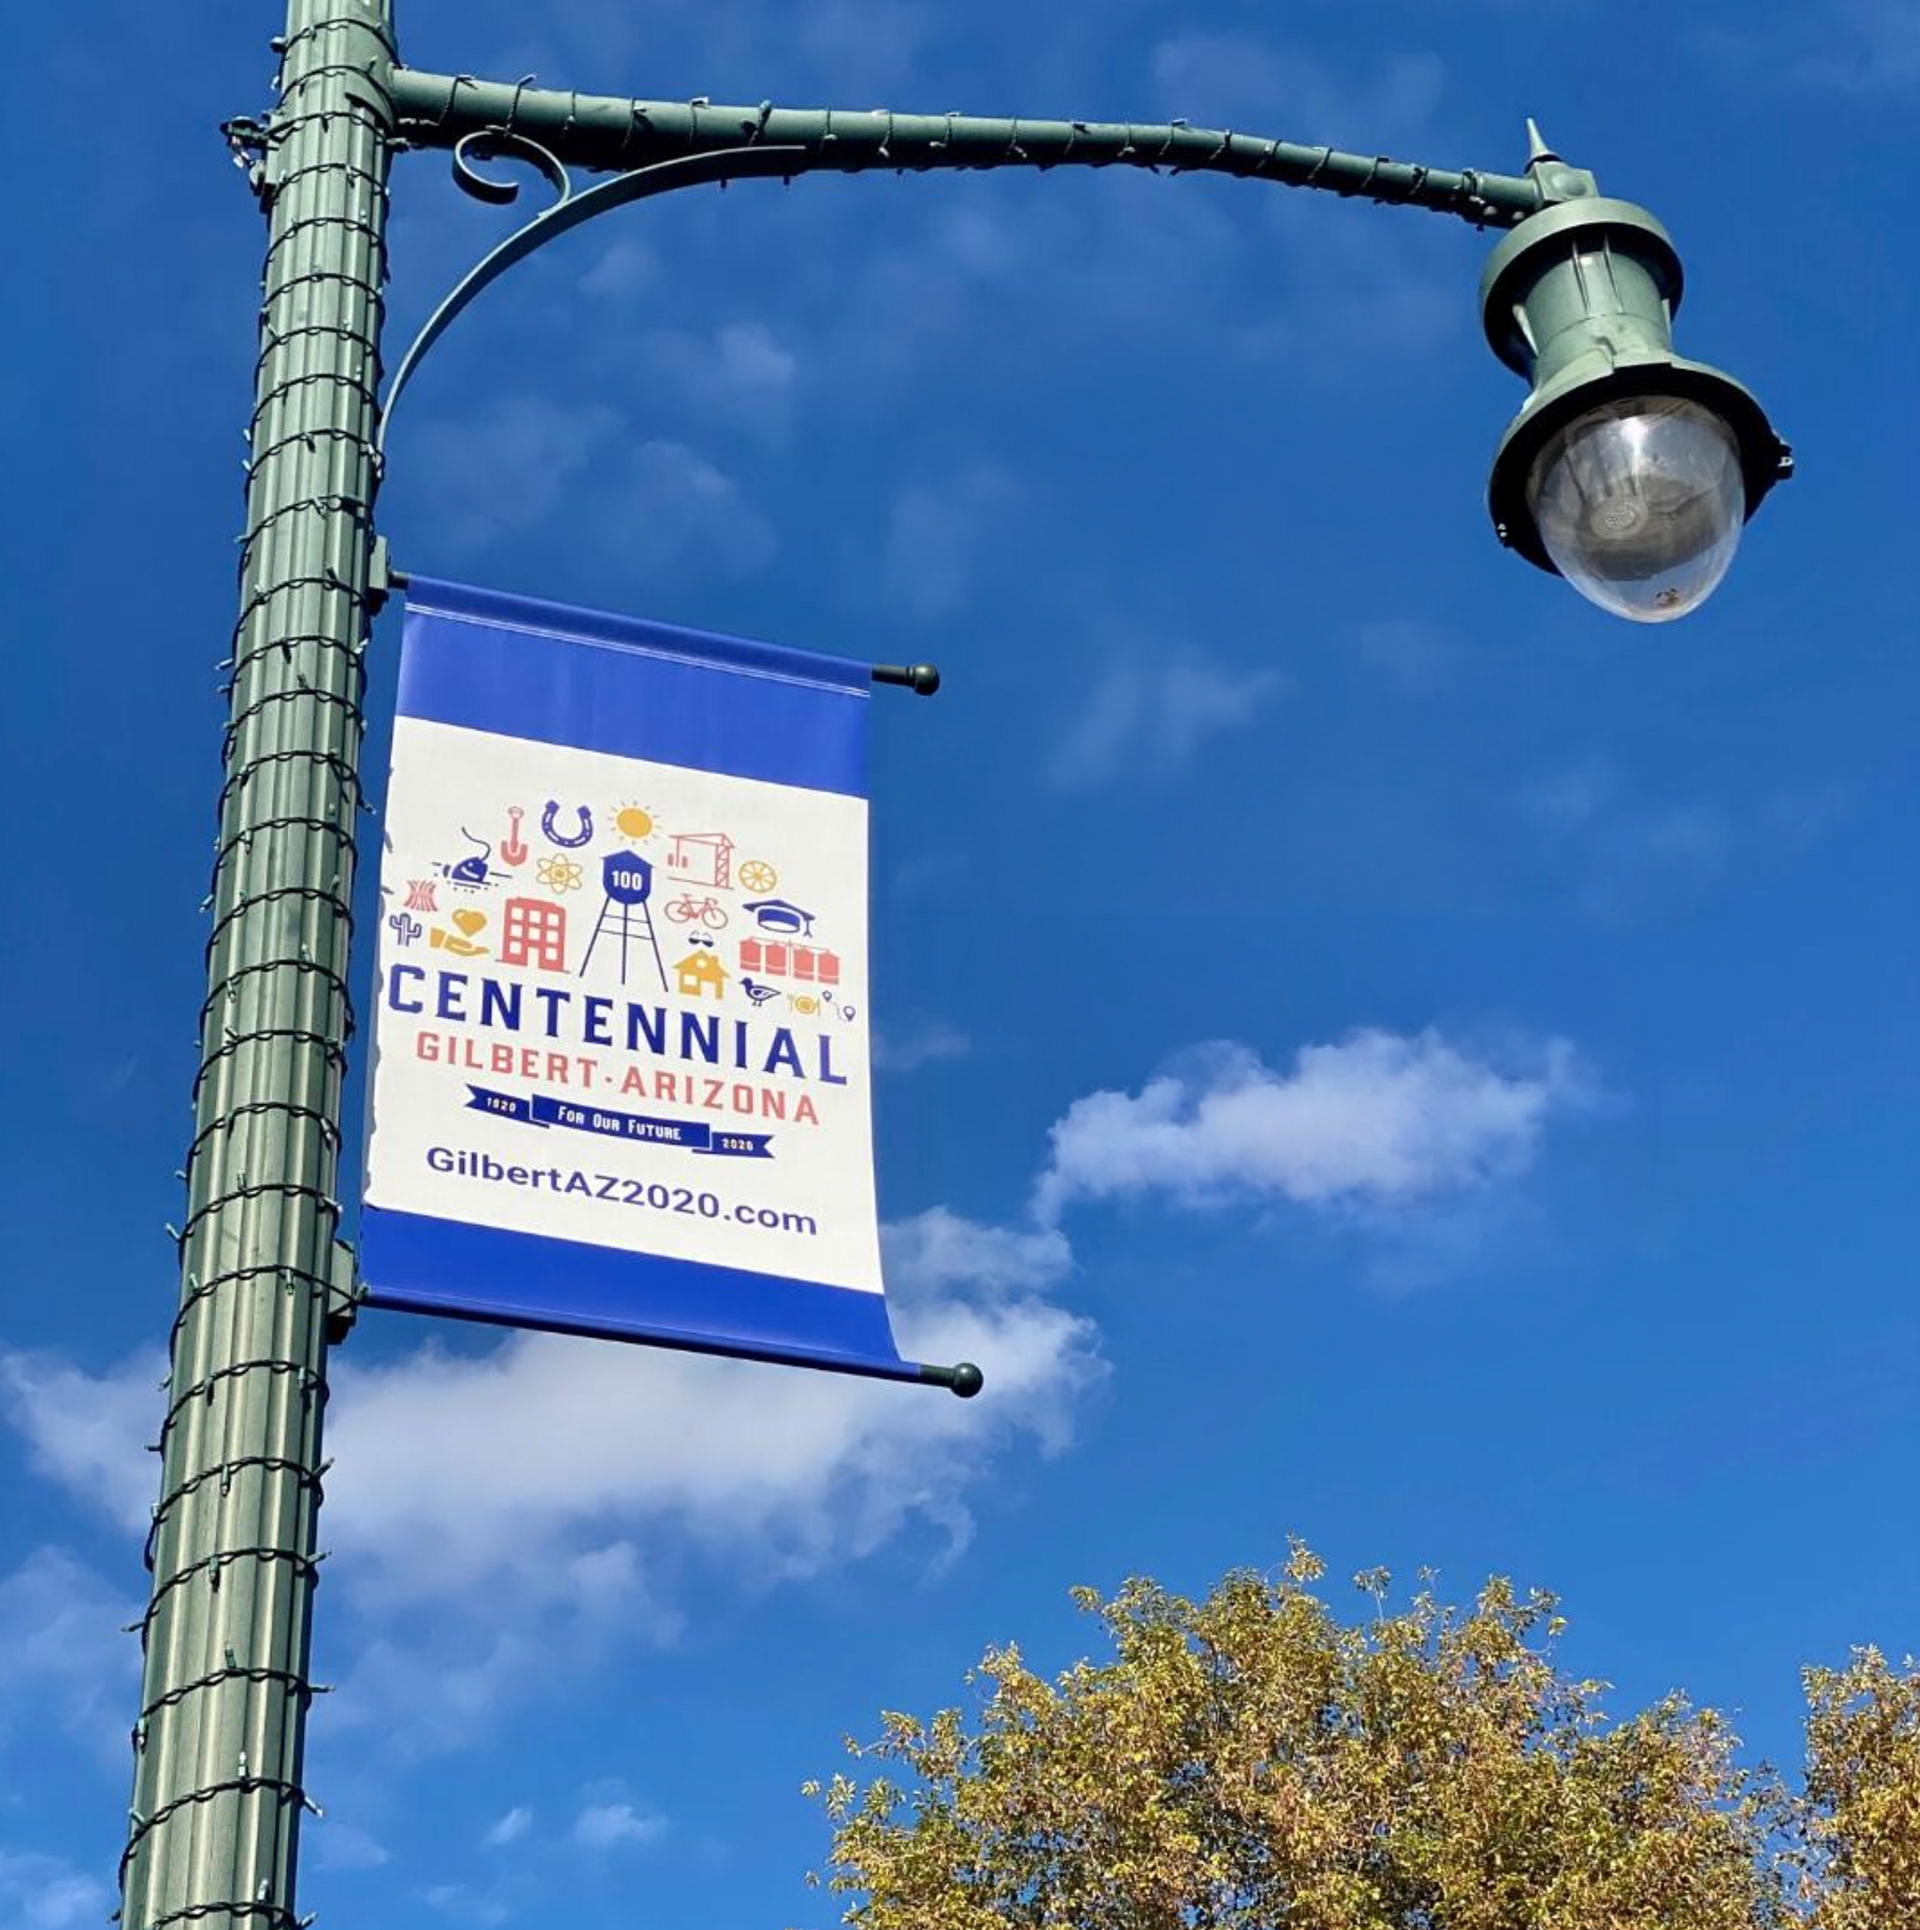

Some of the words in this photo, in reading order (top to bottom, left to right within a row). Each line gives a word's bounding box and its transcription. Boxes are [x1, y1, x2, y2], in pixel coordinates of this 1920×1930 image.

[611, 870, 642, 891] 100
[388, 963, 848, 1085] CENTENNIAL
[486, 1096, 517, 1113] 1920
[721, 1137, 754, 1151] 2020
[426, 1146, 818, 1235] GilbertAZ2020.com
